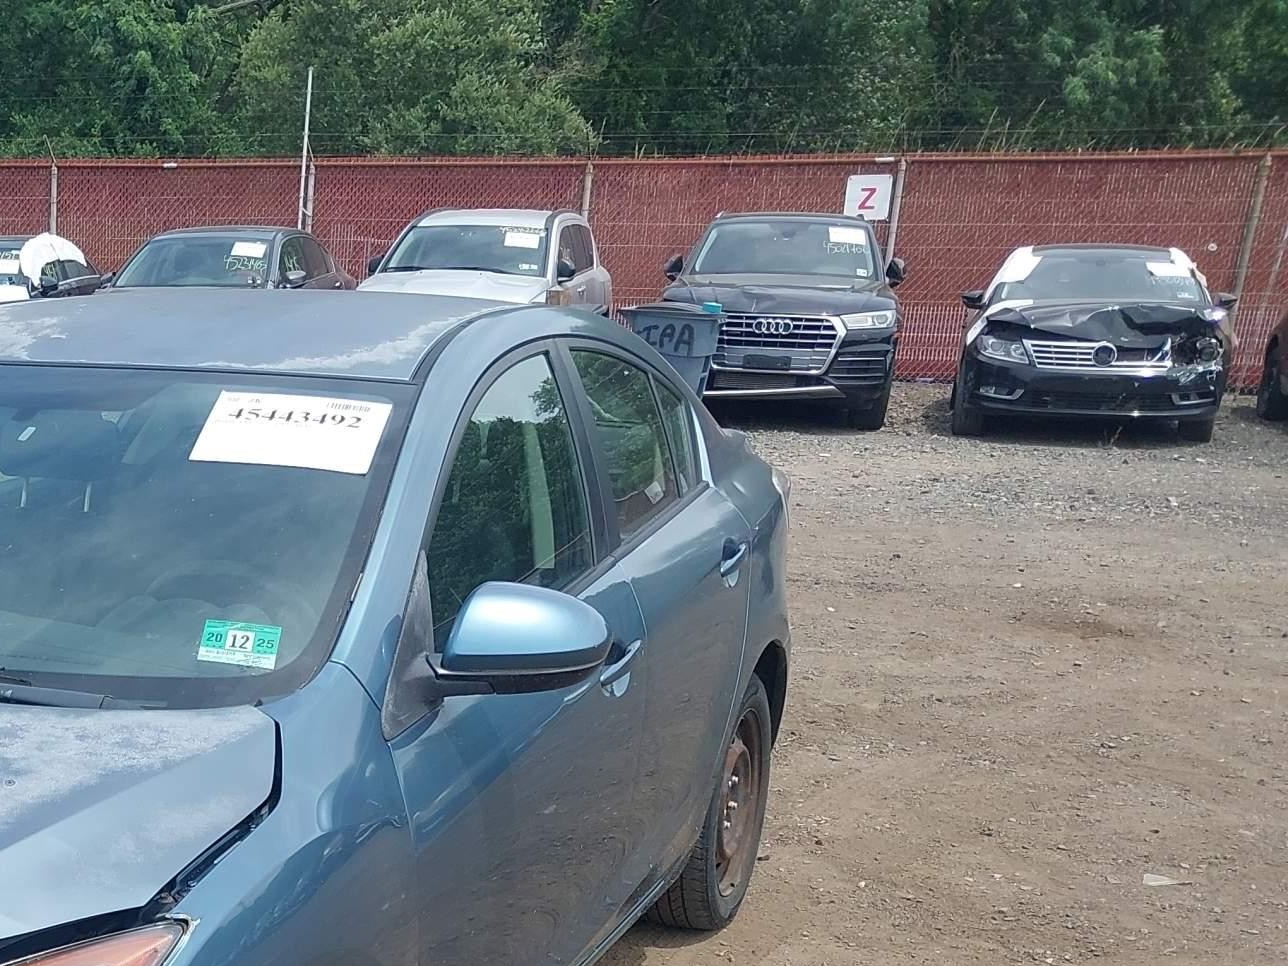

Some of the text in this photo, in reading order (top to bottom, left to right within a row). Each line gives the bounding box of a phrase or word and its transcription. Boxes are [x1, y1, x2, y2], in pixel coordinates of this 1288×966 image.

[857, 187, 877, 210] Z
[228, 407, 363, 429] 45443492
[206, 632, 275, 650] 20 12 25
